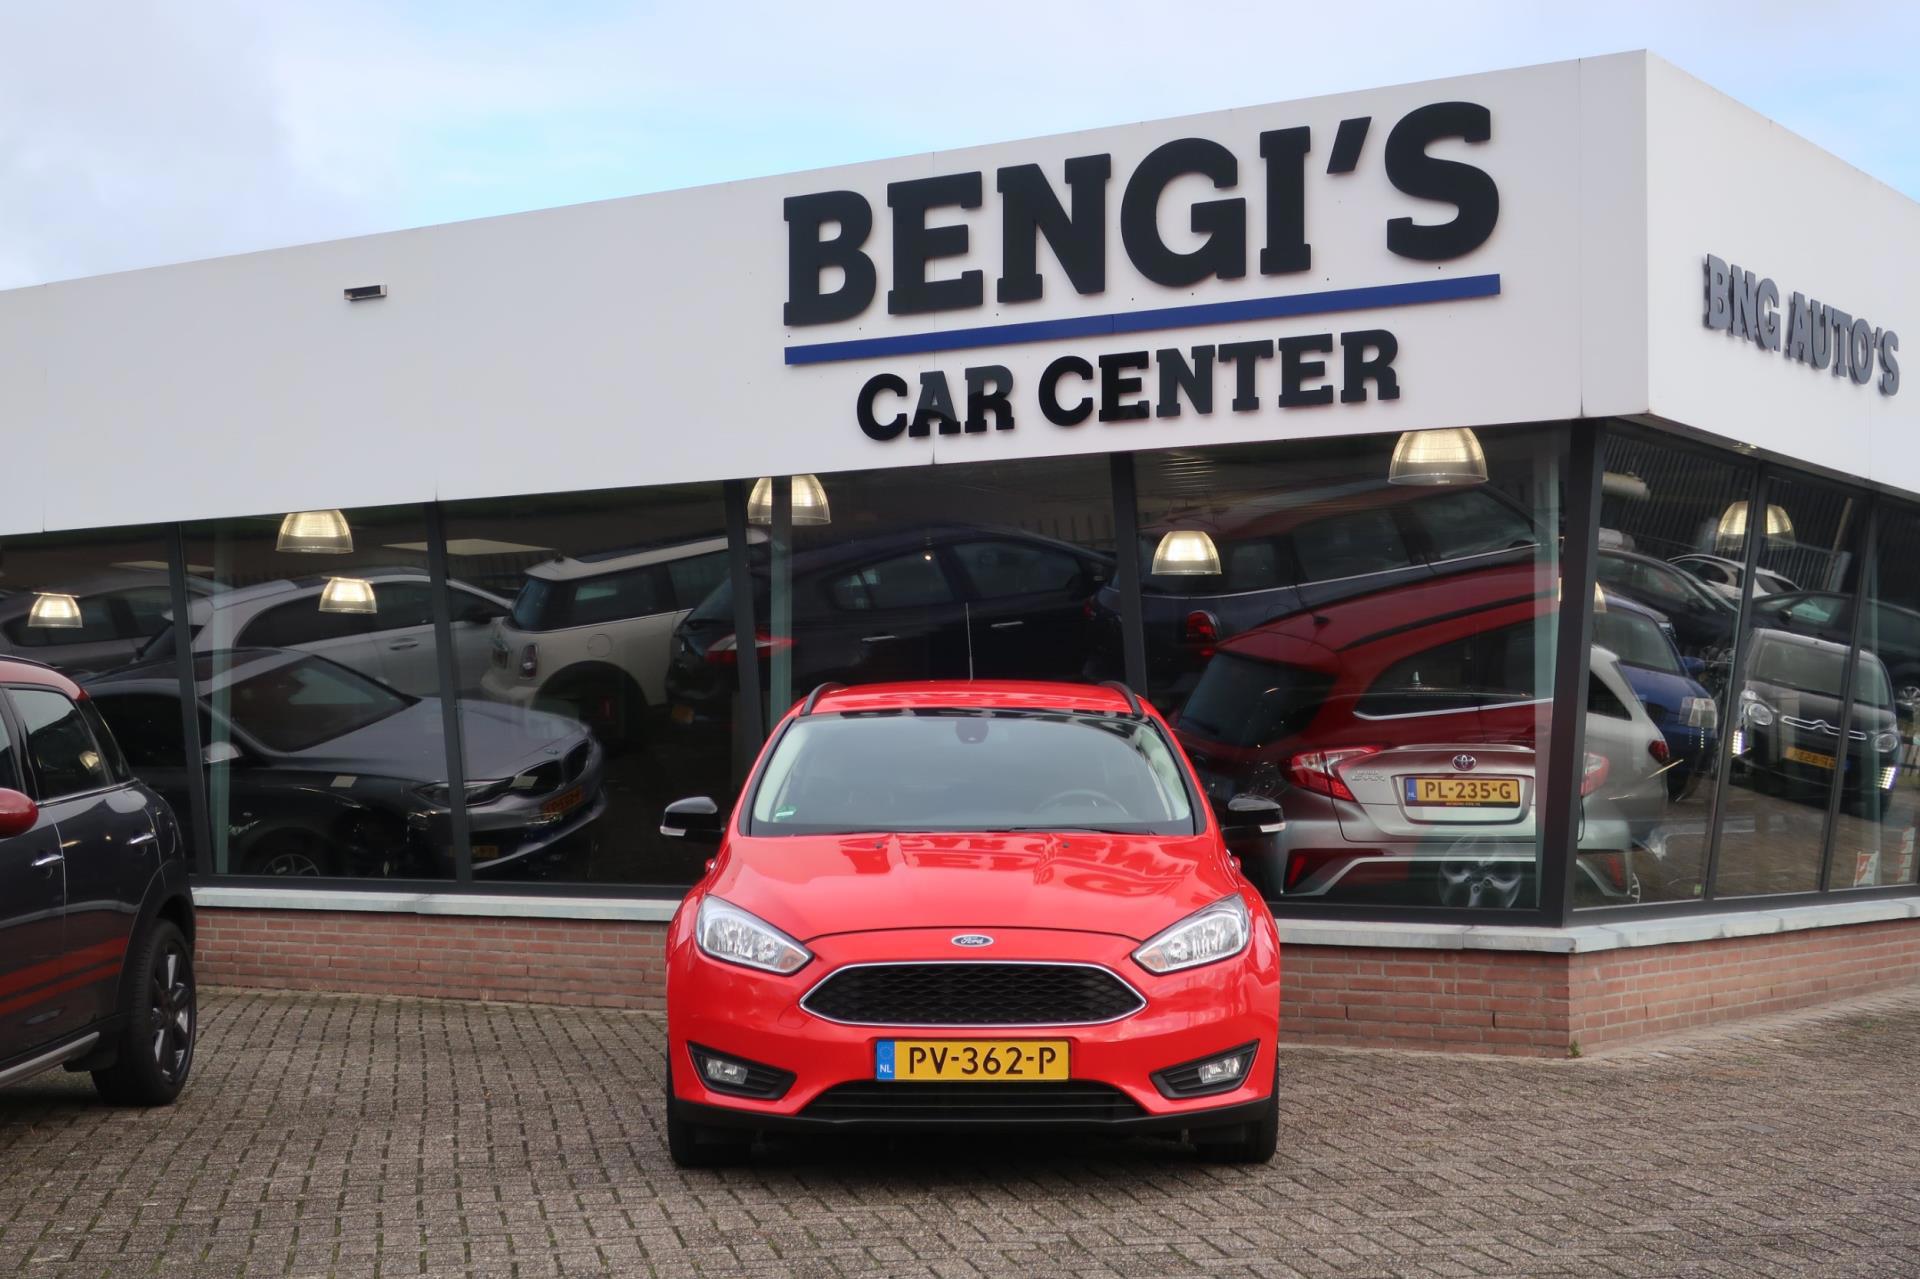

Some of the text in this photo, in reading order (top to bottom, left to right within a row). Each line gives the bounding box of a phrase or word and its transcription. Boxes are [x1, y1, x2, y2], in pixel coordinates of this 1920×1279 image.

[784, 101, 1500, 327] BENGI'S
[1704, 253, 1900, 397] BNG AUTO'S
[856, 328, 1401, 441] CAR CENTER
[1424, 781, 1512, 800] PL-235-G
[879, 1046, 1057, 1075] NL PV-362-P
